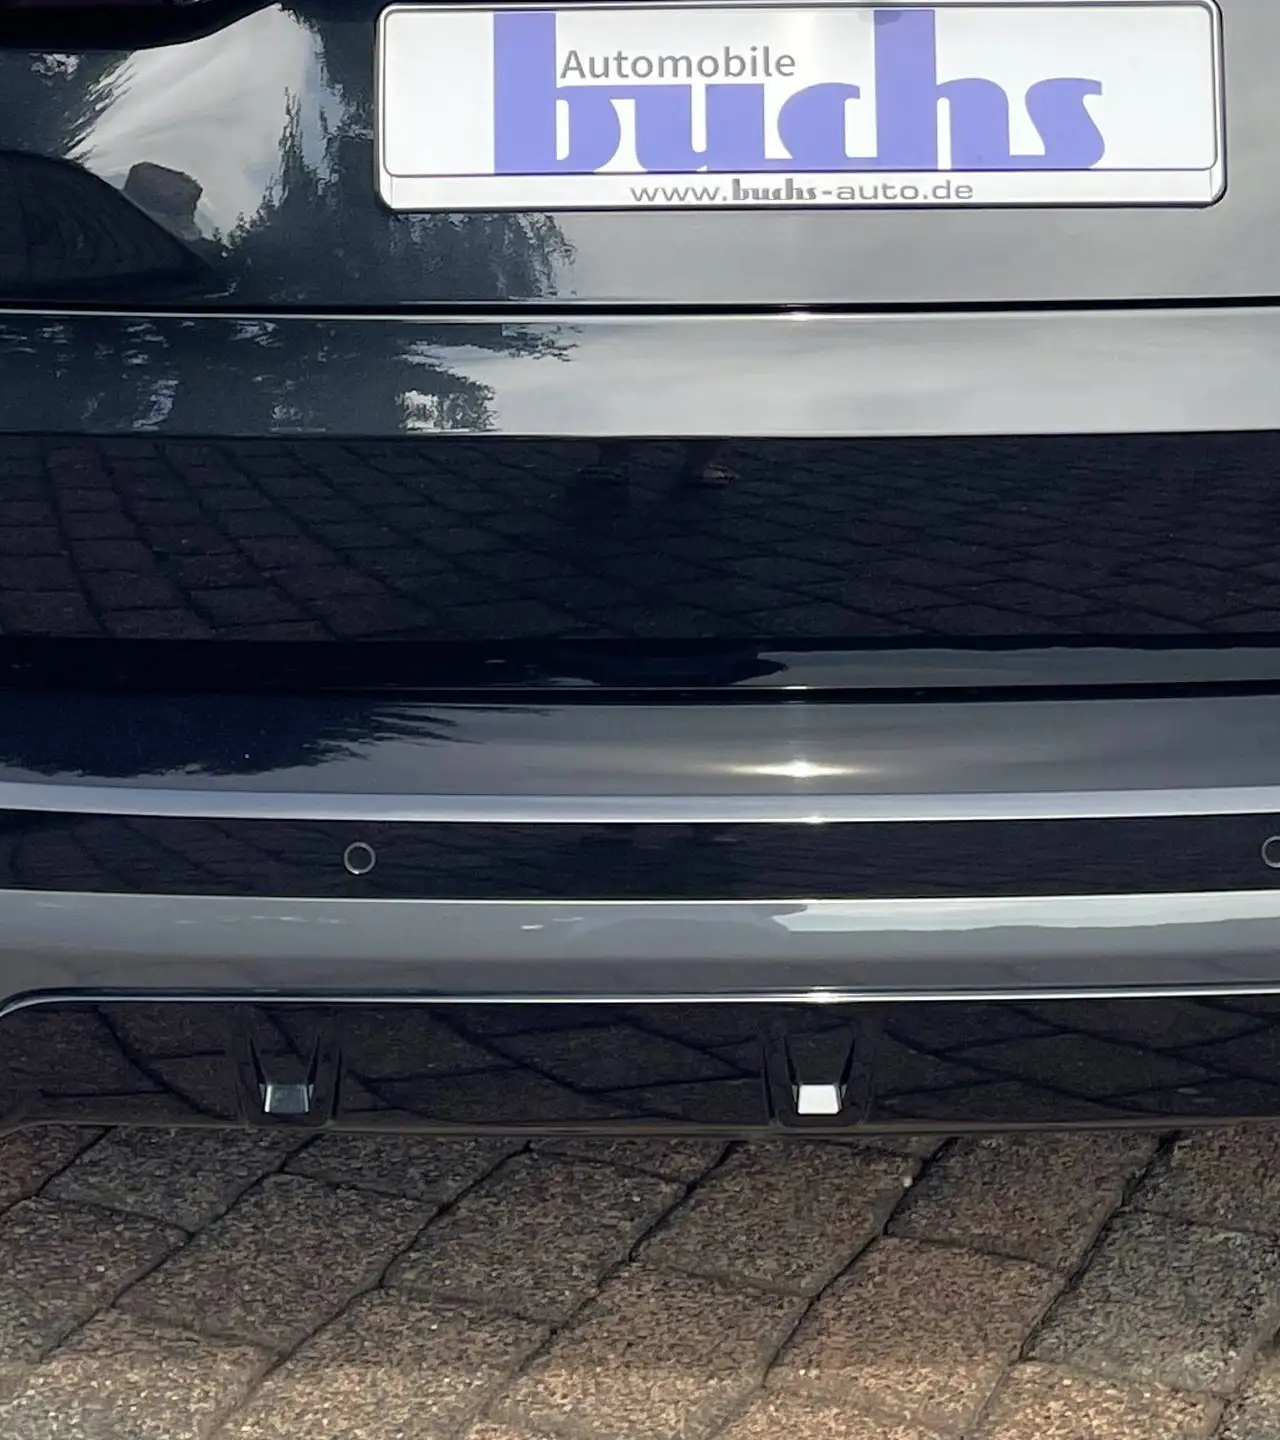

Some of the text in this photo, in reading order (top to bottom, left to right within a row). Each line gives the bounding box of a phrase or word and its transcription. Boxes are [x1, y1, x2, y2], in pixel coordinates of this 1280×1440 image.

[559, 45, 797, 79] Automobile
[494, 10, 1106, 174] buchs
[629, 177, 975, 203] www.buchs-auto.de
